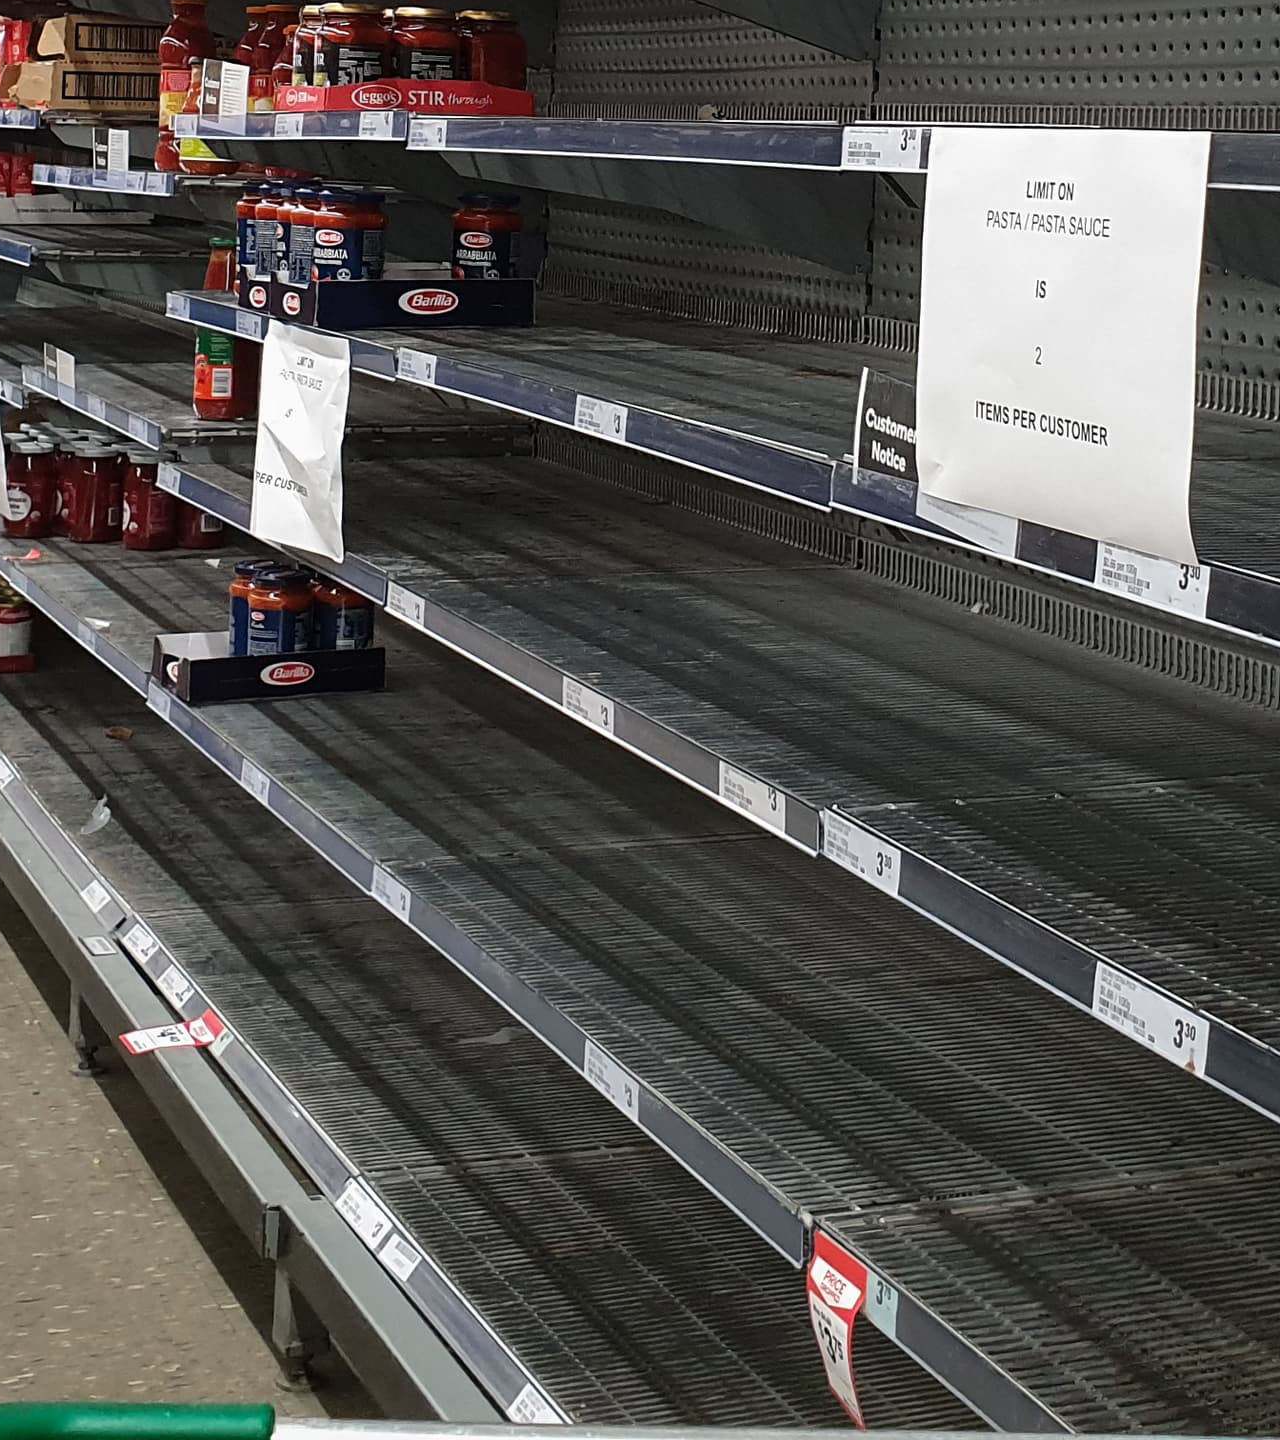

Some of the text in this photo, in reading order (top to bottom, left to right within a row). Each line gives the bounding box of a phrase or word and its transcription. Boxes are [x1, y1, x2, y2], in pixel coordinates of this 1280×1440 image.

[358, 87, 495, 108] Leggo's STIR through
[1026, 181, 1075, 201] LIMIT ON
[986, 210, 1111, 238] PASTA / PASTA SAUCE
[1035, 279, 1046, 299] IS
[411, 293, 452, 307] Barilla
[1035, 346, 1042, 365] 2
[975, 400, 1109, 447] ITEMS PER CUSTOMER
[871, 440, 906, 472] Notice
[273, 666, 310, 680] Barilla
[823, 1269, 847, 1296] PRICE
